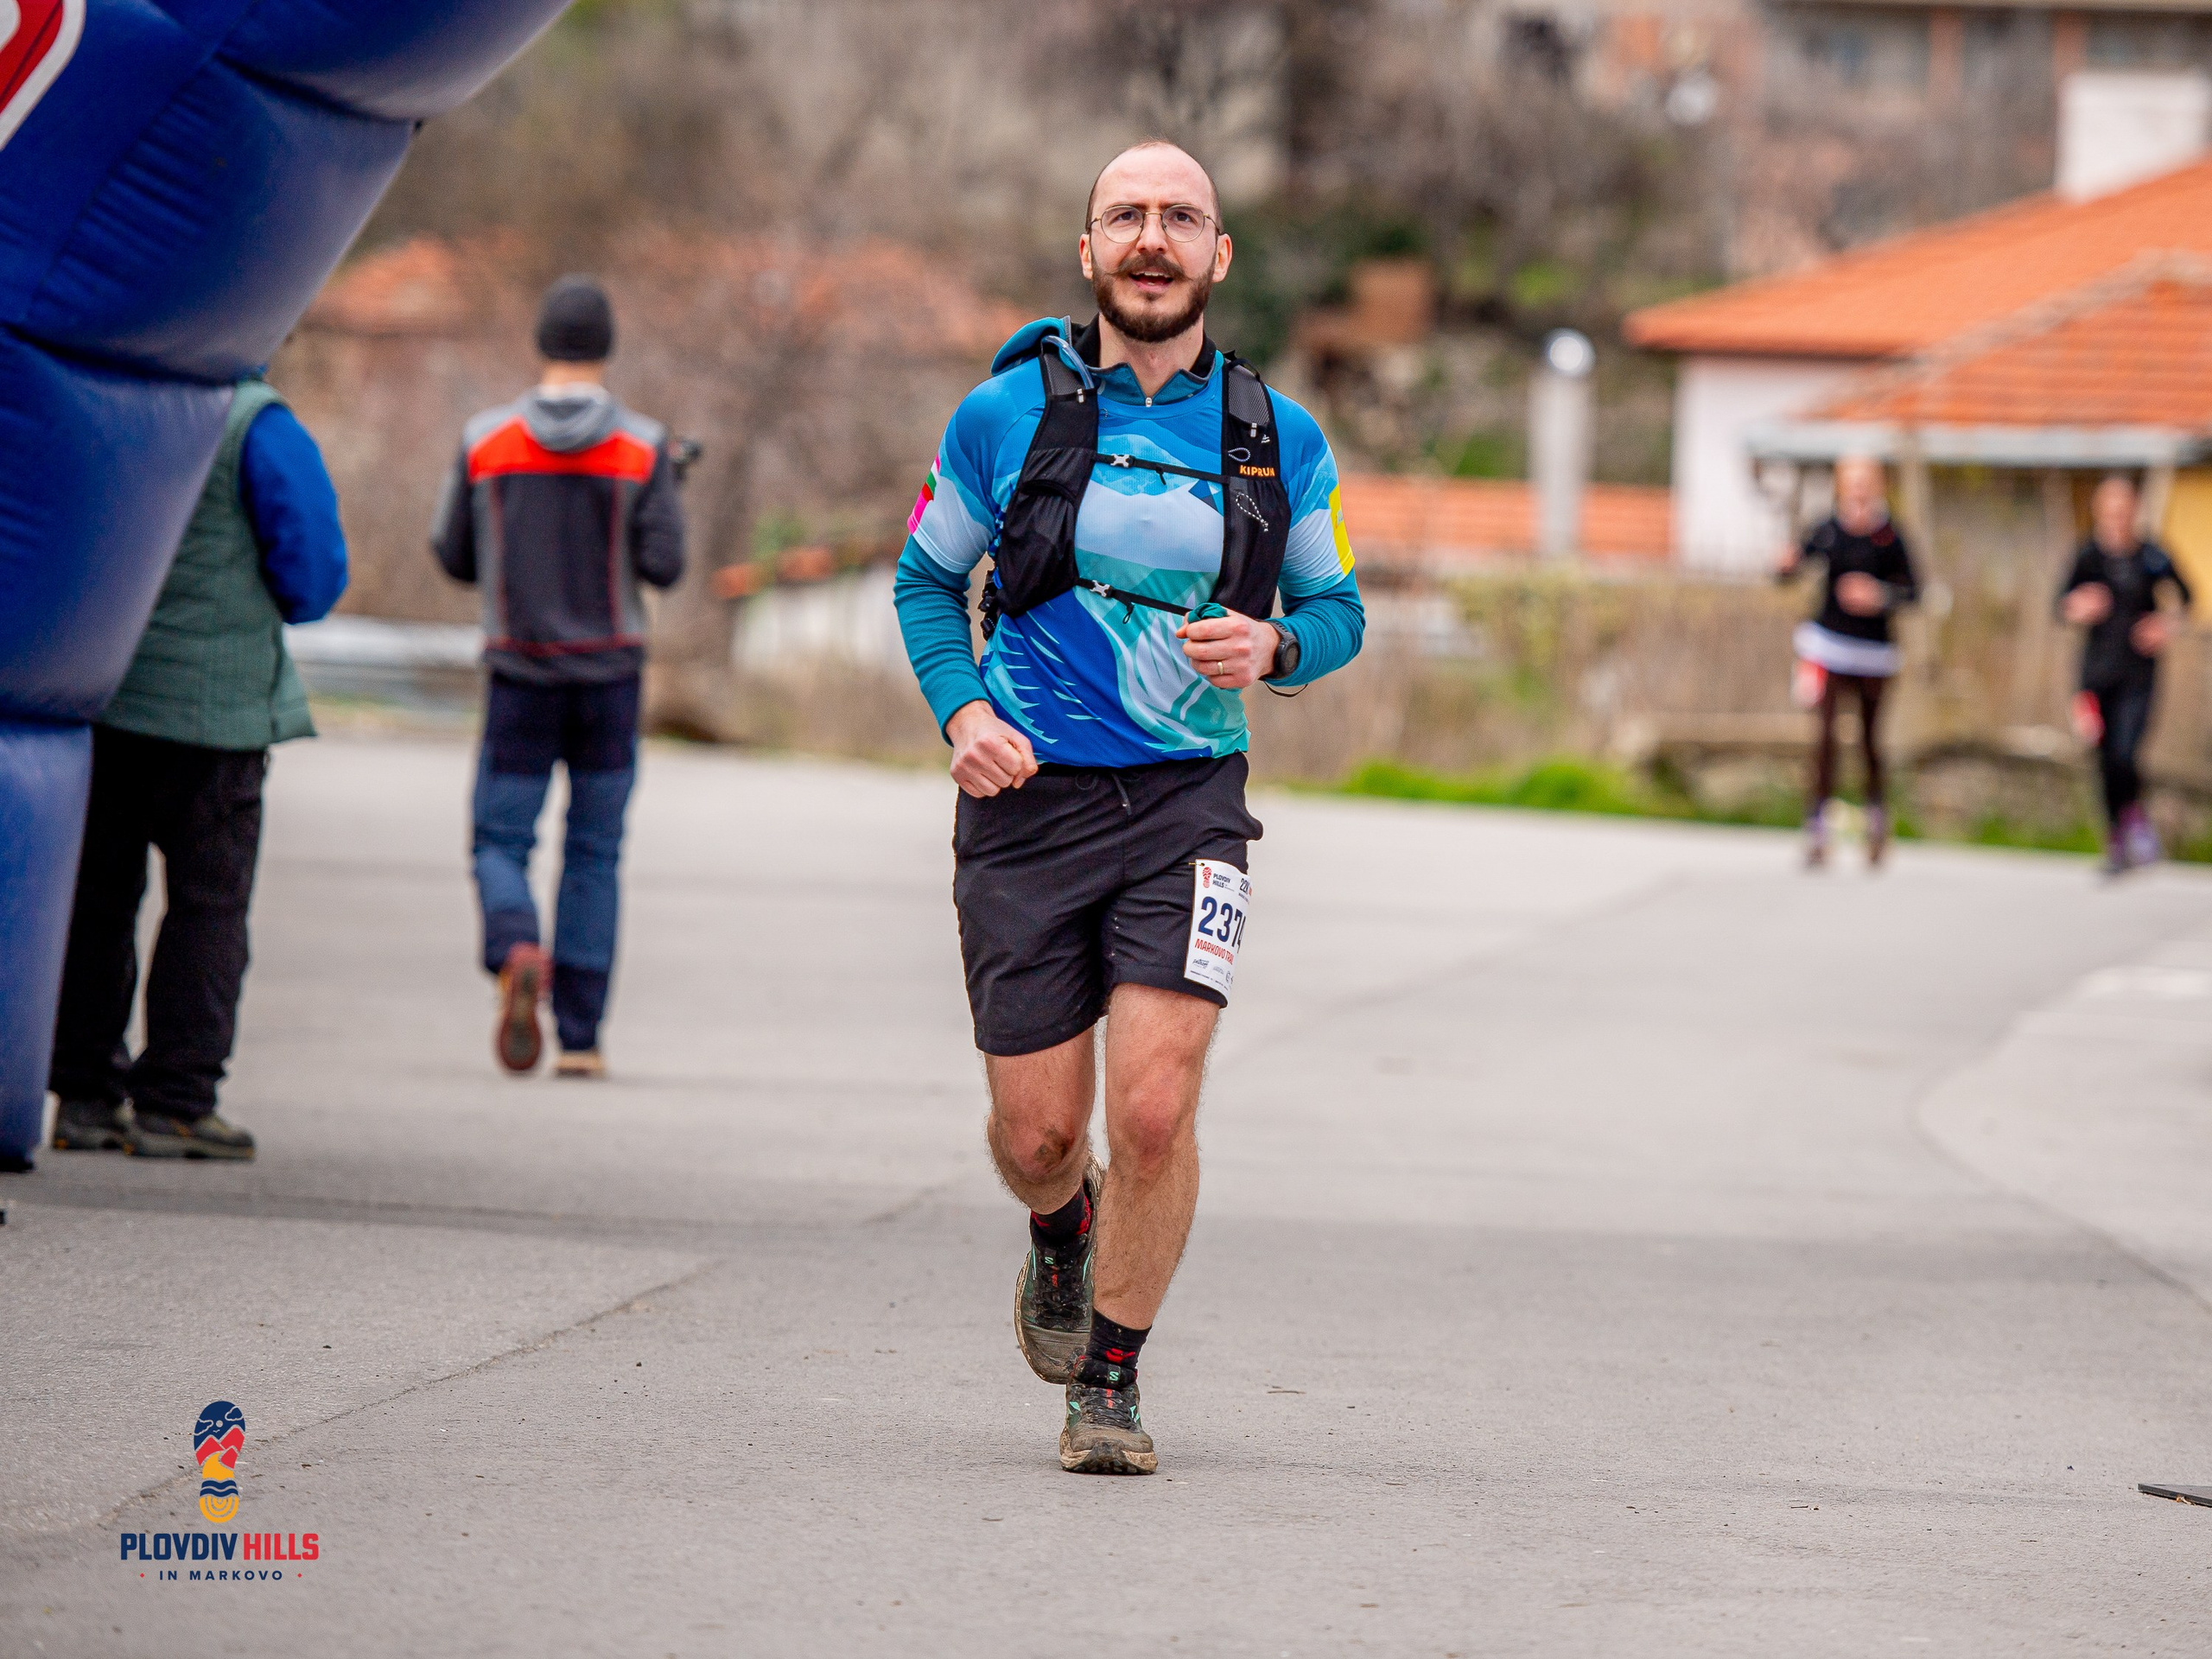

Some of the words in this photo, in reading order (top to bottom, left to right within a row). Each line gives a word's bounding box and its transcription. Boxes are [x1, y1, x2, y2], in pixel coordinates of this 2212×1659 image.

[1239, 465, 1275, 476] KIPRUN
[1212, 873, 1230, 883] PLOVDIV
[1212, 880, 1224, 888] HILLS
[1194, 938, 1226, 959] MARKOVO
